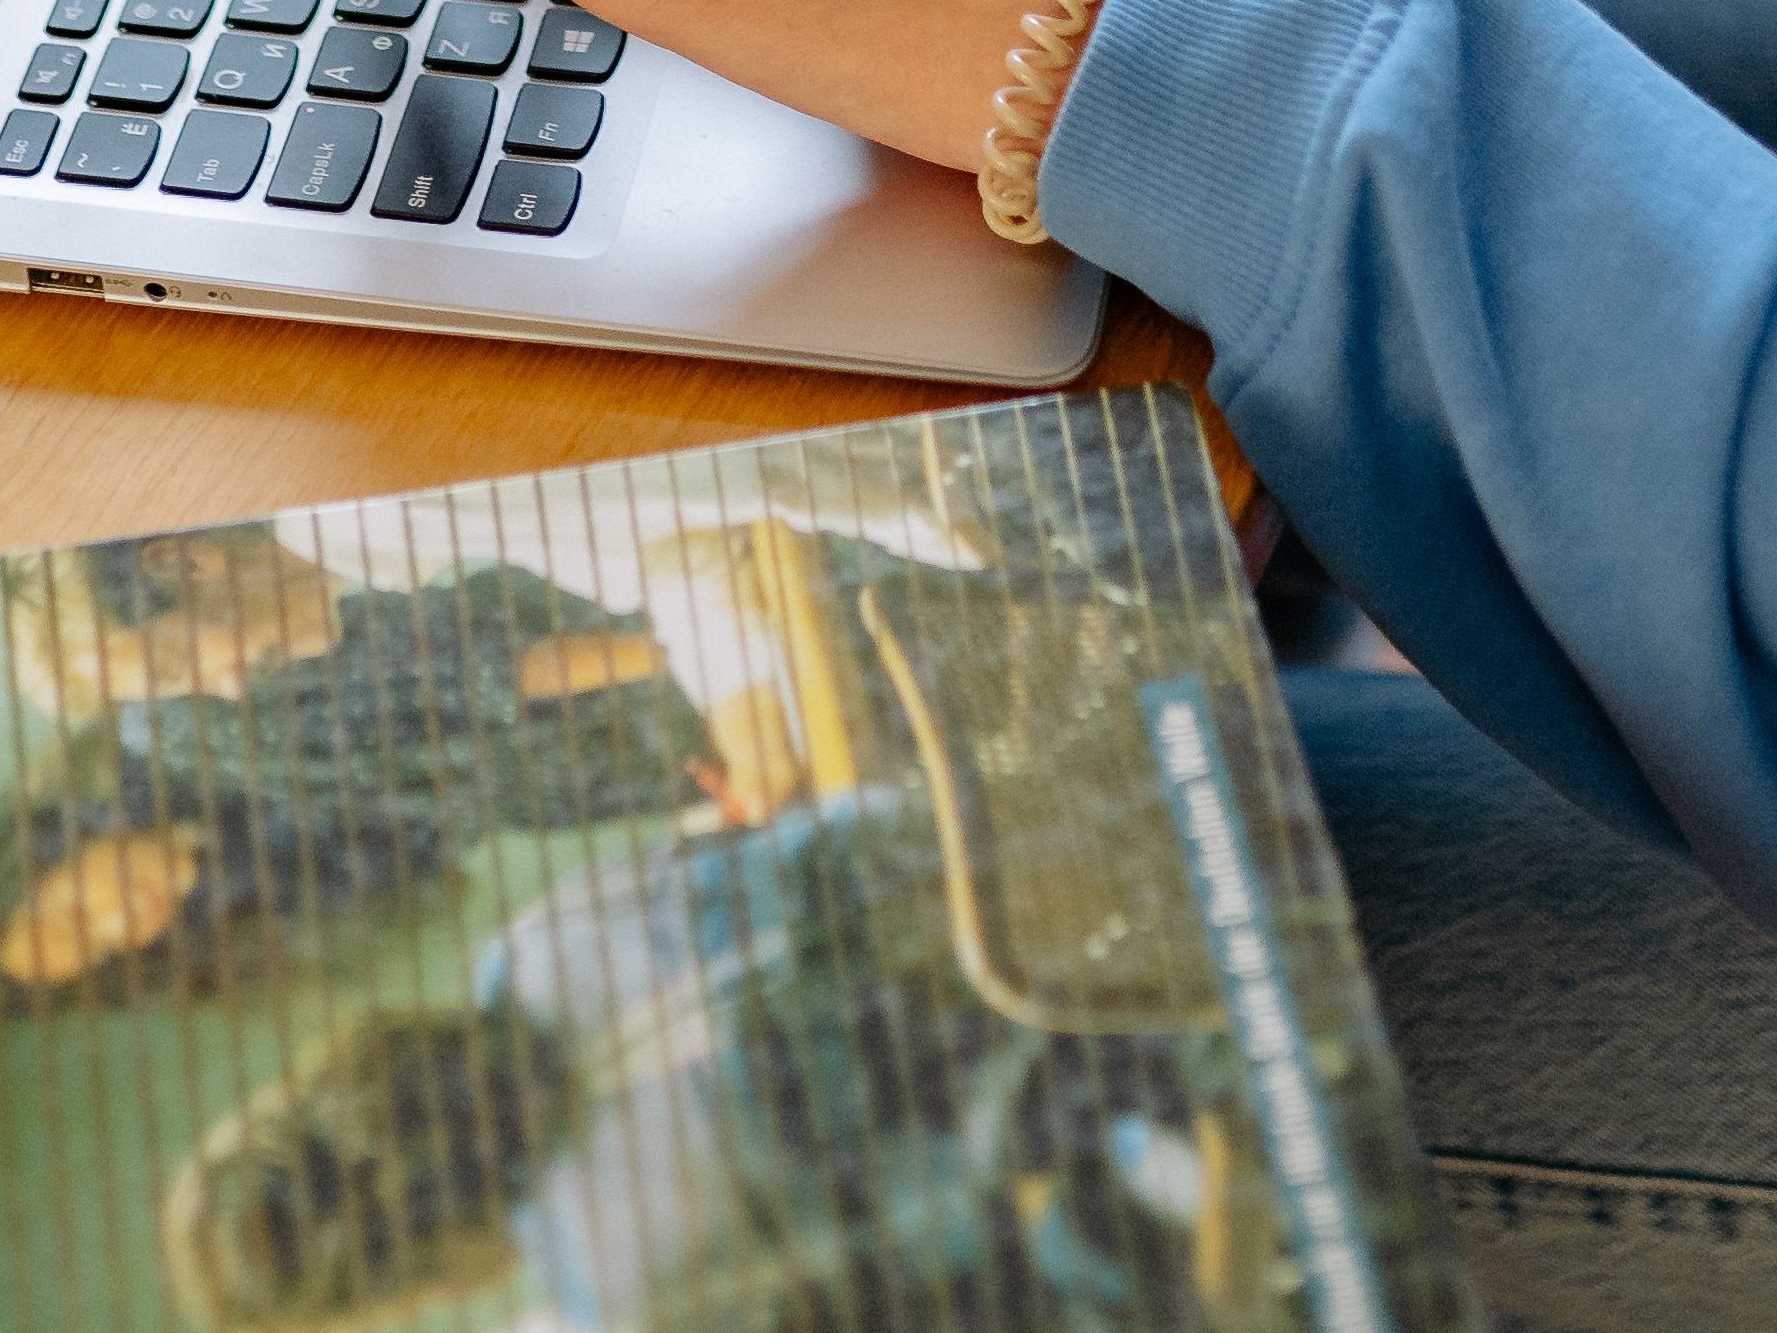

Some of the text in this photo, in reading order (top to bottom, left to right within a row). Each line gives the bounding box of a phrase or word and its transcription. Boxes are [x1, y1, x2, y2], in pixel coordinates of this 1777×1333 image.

[169, 6, 195, 21] 2
[372, 35, 393, 52] Ф
[438, 39, 470, 58] Z
[213, 69, 246, 90] Q
[323, 64, 355, 84] A
[538, 121, 559, 141] Fn
[5, 138, 29, 164] Esc
[197, 158, 220, 183] Tab
[302, 140, 337, 196] CapsLk
[408, 175, 434, 209] Shift
[513, 192, 538, 221] Ctrl
